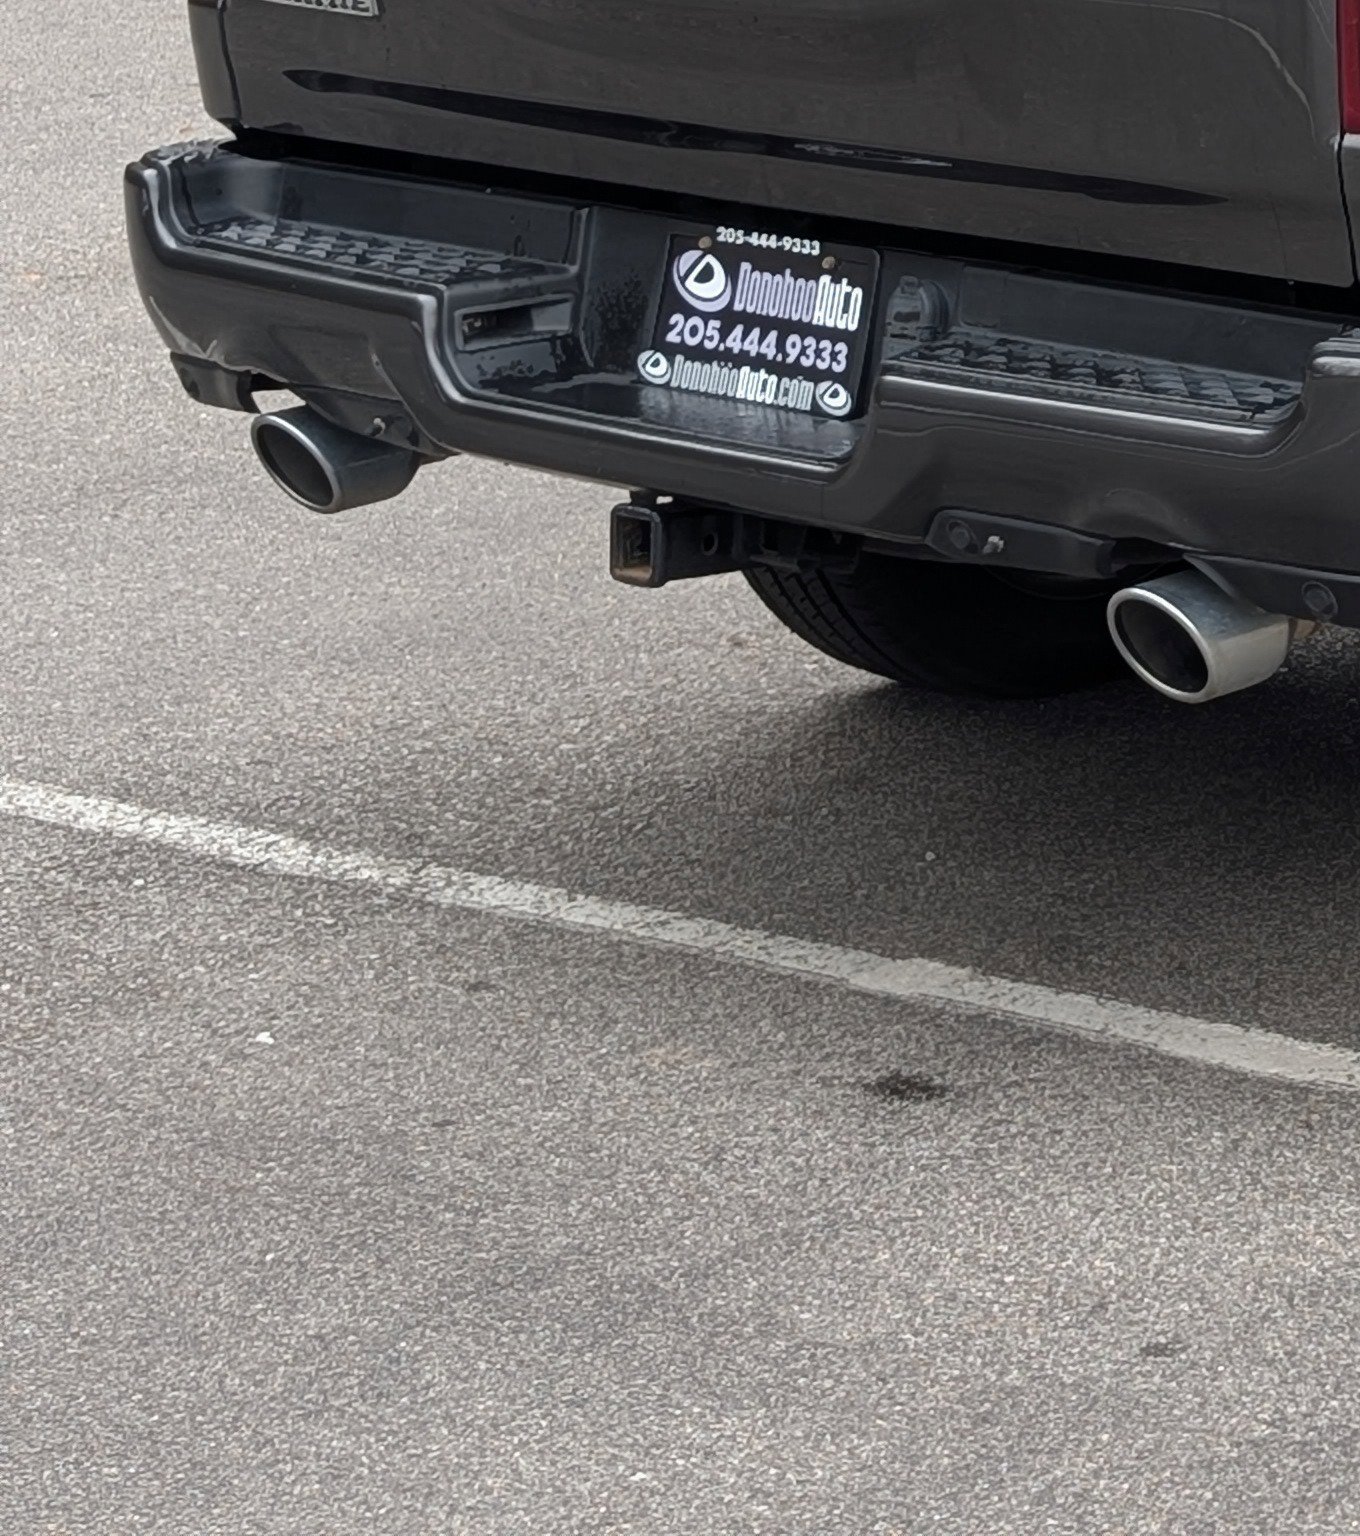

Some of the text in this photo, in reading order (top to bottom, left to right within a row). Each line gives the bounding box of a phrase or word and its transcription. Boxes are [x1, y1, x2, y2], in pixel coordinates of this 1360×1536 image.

[716, 226, 821, 256] 205-444-9333
[733, 262, 863, 332] DonohooAuto
[665, 313, 848, 373] 205.444.9333
